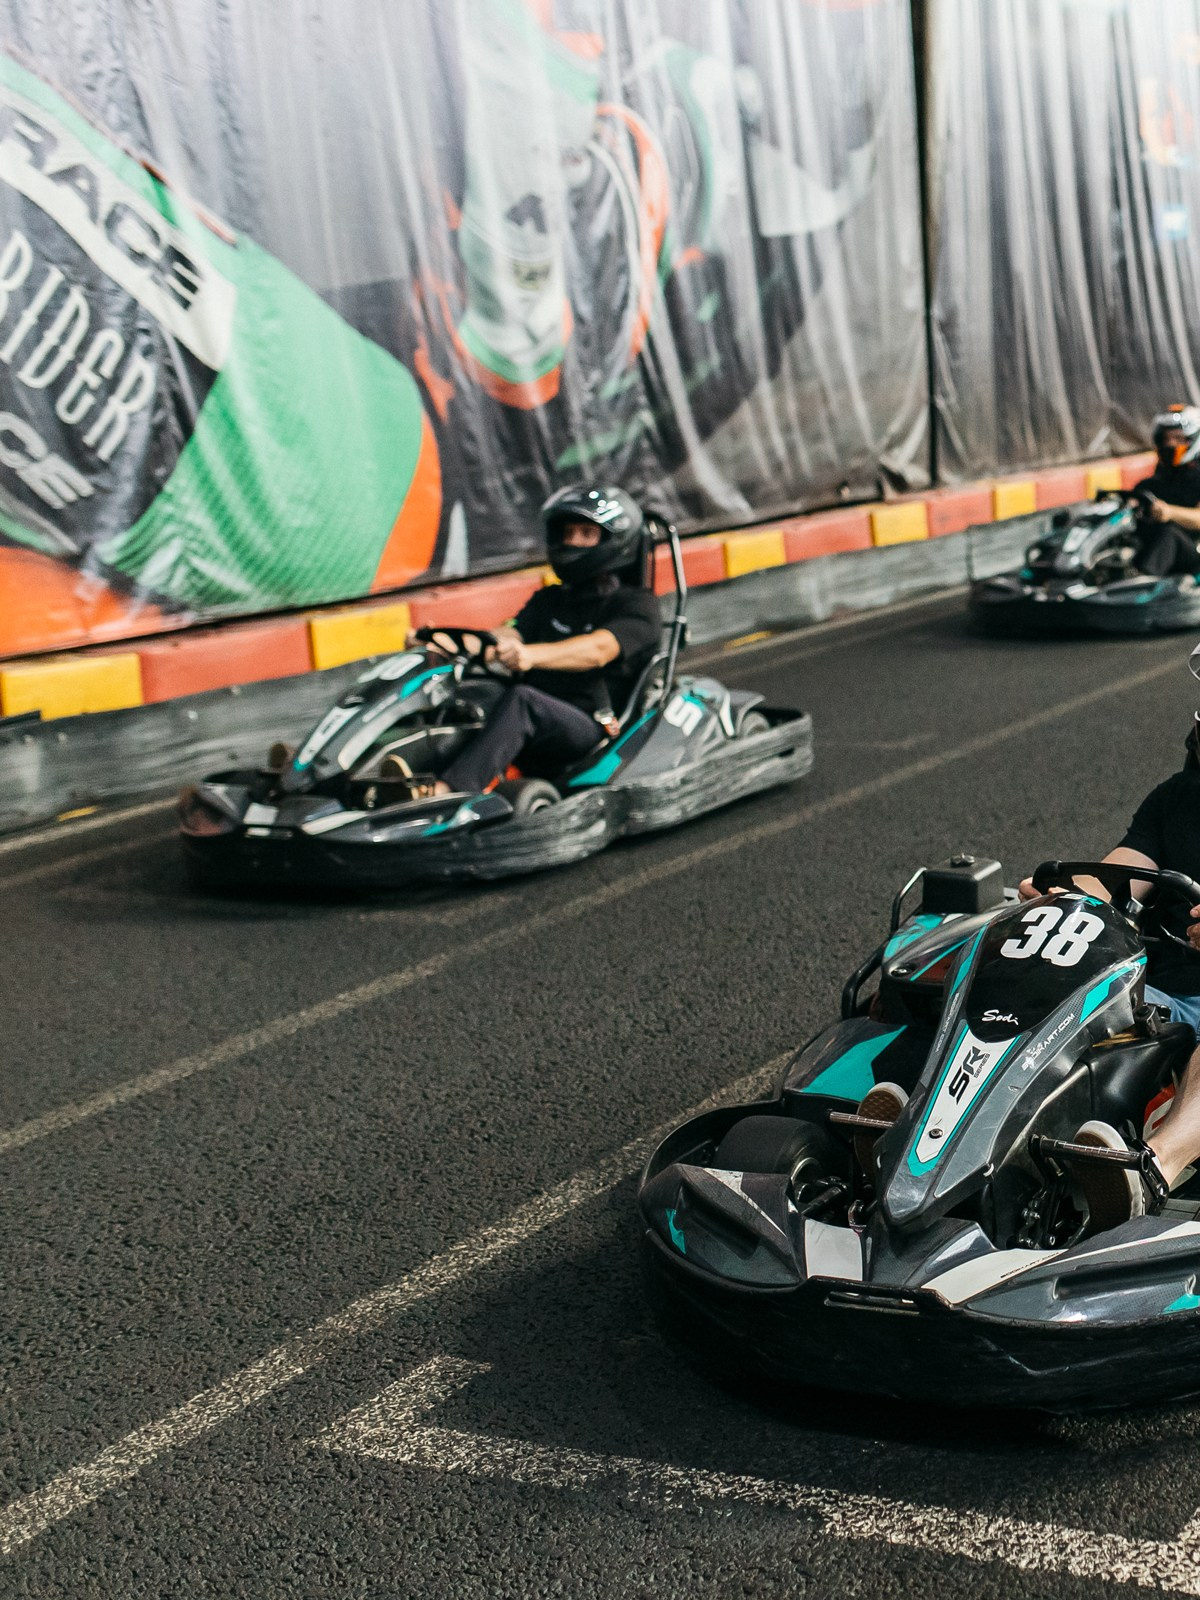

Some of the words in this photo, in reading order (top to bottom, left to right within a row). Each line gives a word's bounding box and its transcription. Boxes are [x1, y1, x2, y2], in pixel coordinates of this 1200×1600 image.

[0, 104, 201, 312] RACE
[1000, 906, 1105, 967] 38
[982, 1009, 1019, 1025] Sodi
